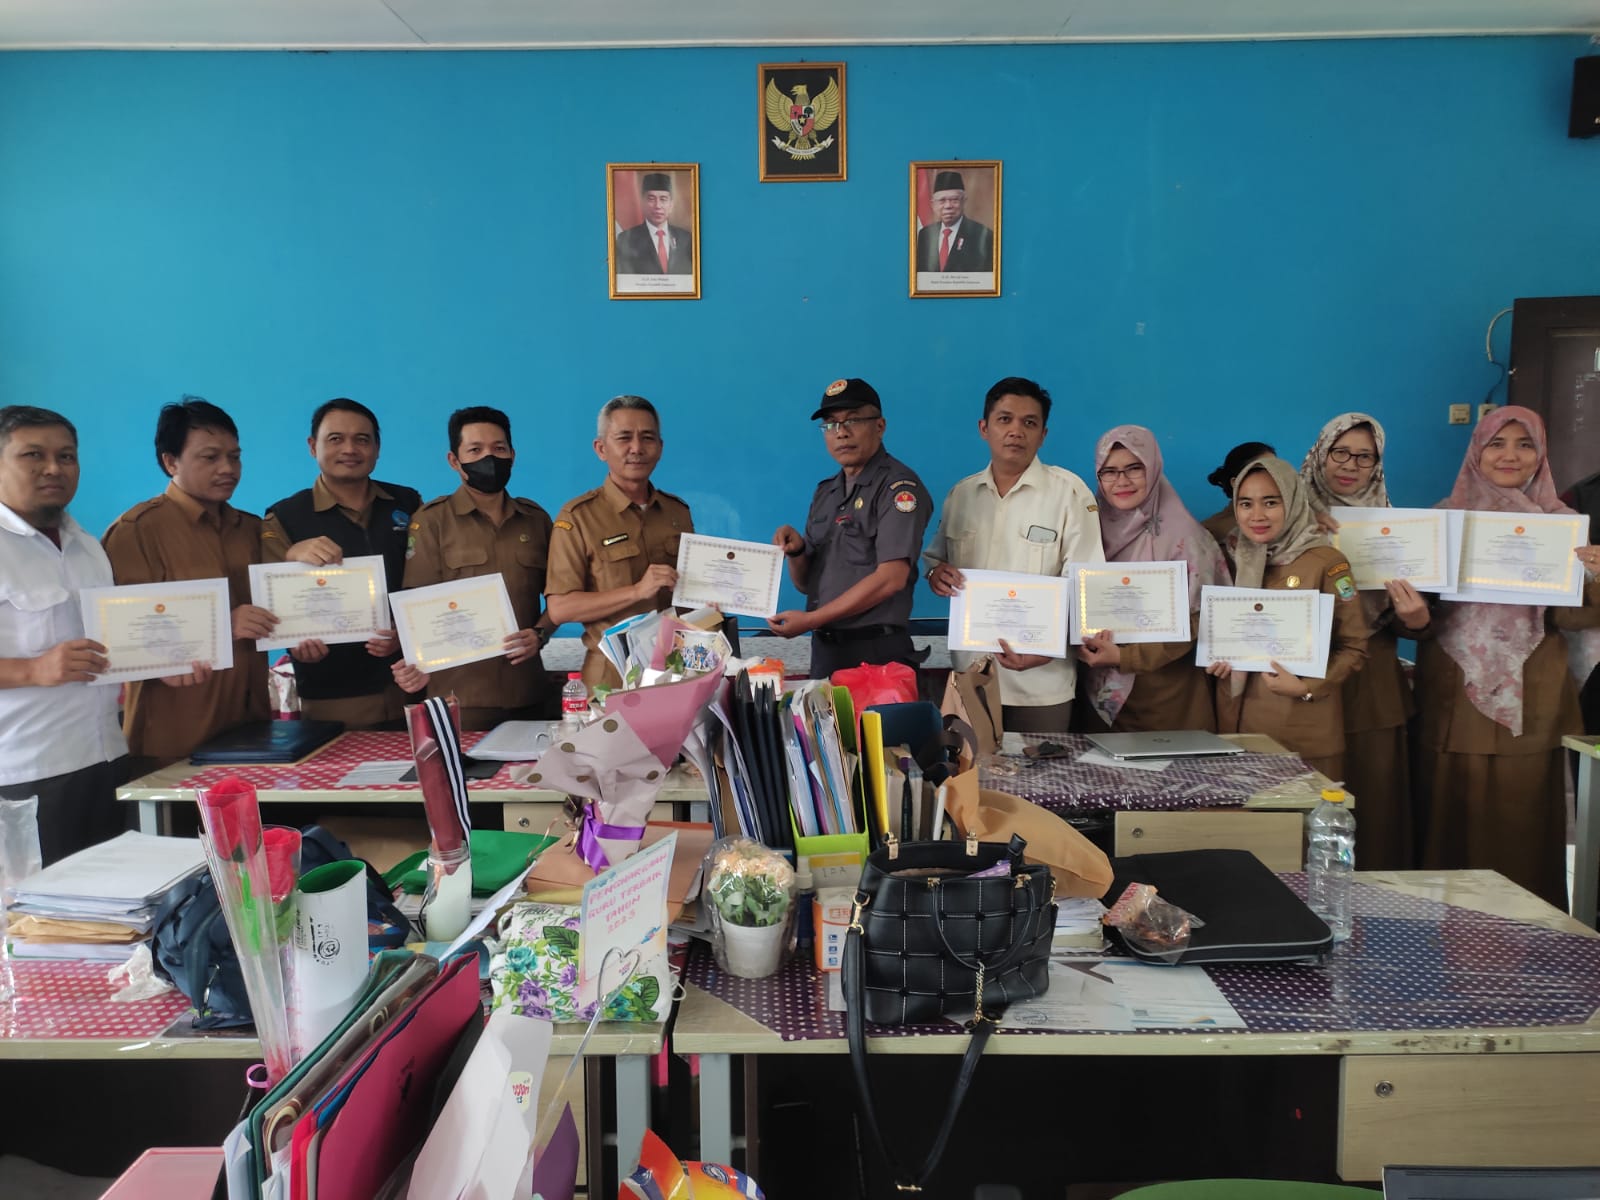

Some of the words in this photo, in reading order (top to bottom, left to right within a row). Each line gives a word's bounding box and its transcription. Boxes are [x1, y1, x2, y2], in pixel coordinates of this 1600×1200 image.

[588, 896, 616, 919] GURU
[621, 870, 662, 900] TERBAIK
[605, 894, 641, 922] TAHUN
